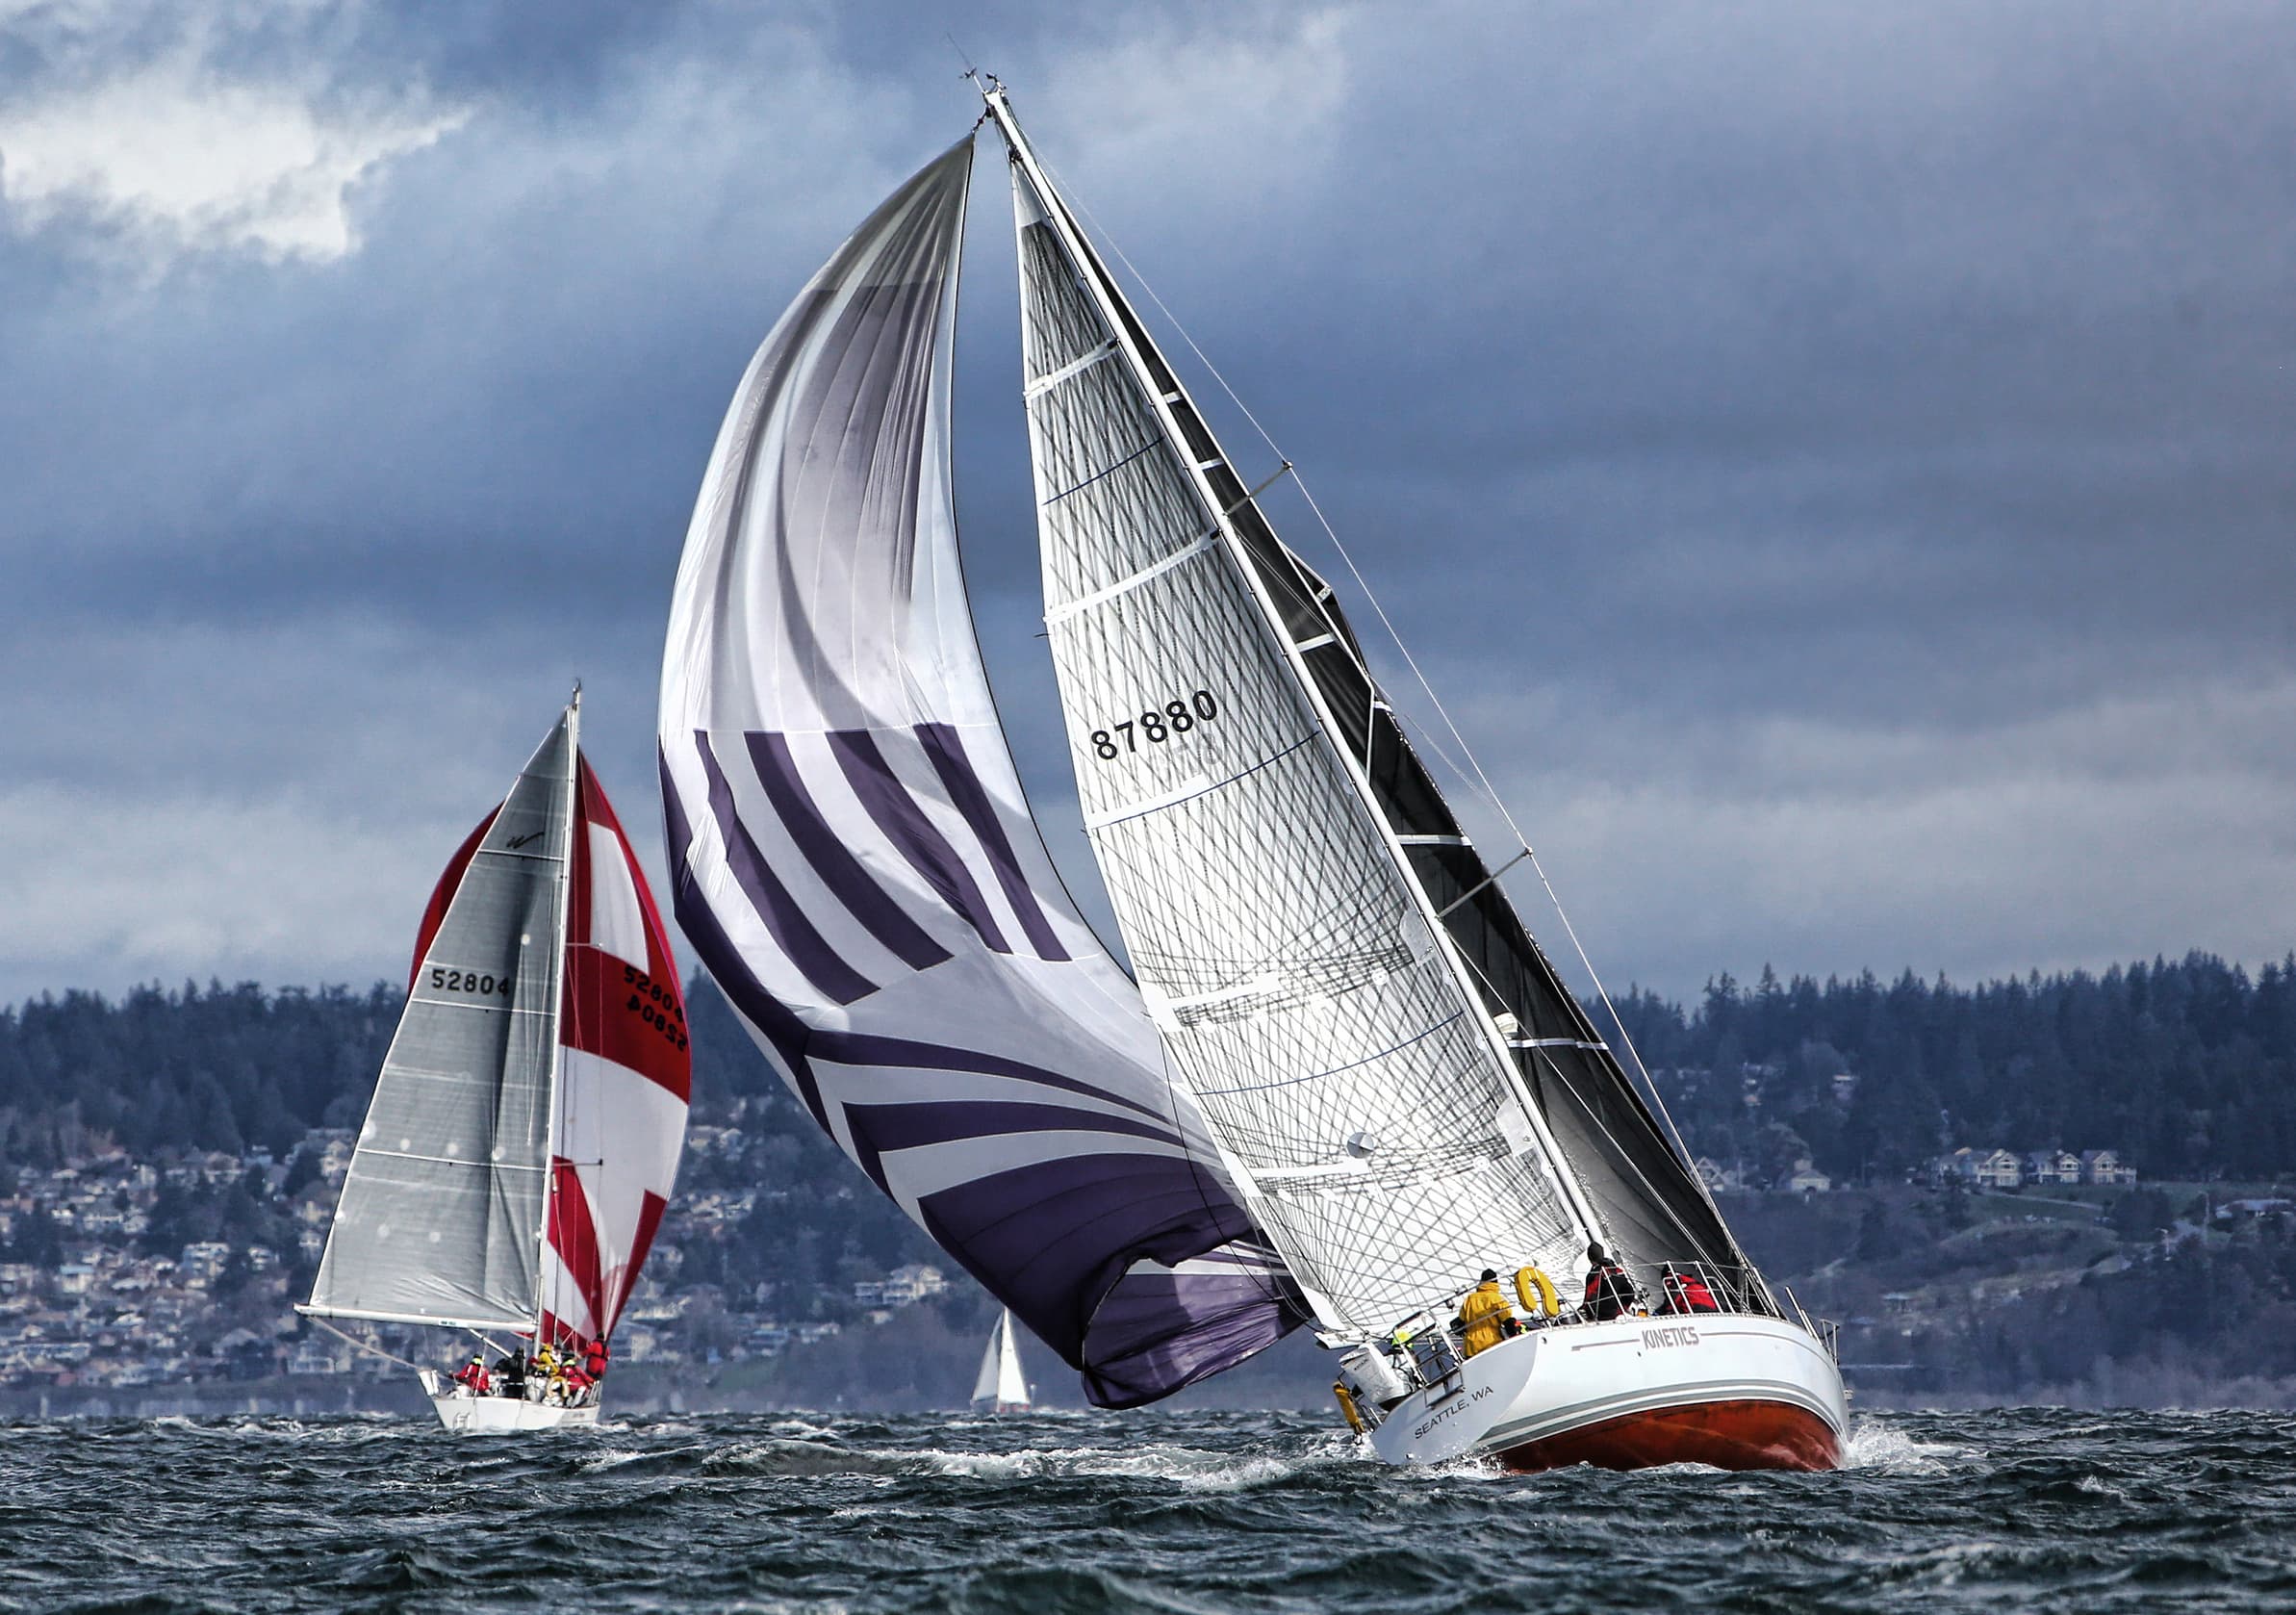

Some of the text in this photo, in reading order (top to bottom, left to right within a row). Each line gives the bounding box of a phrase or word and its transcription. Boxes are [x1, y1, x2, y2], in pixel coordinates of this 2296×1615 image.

[1091, 690, 1218, 760] 87880
[431, 968, 510, 997] 52804
[1642, 1326, 1699, 1349] KINETICS
[1415, 1386, 1493, 1440] SEATTLE, WA
